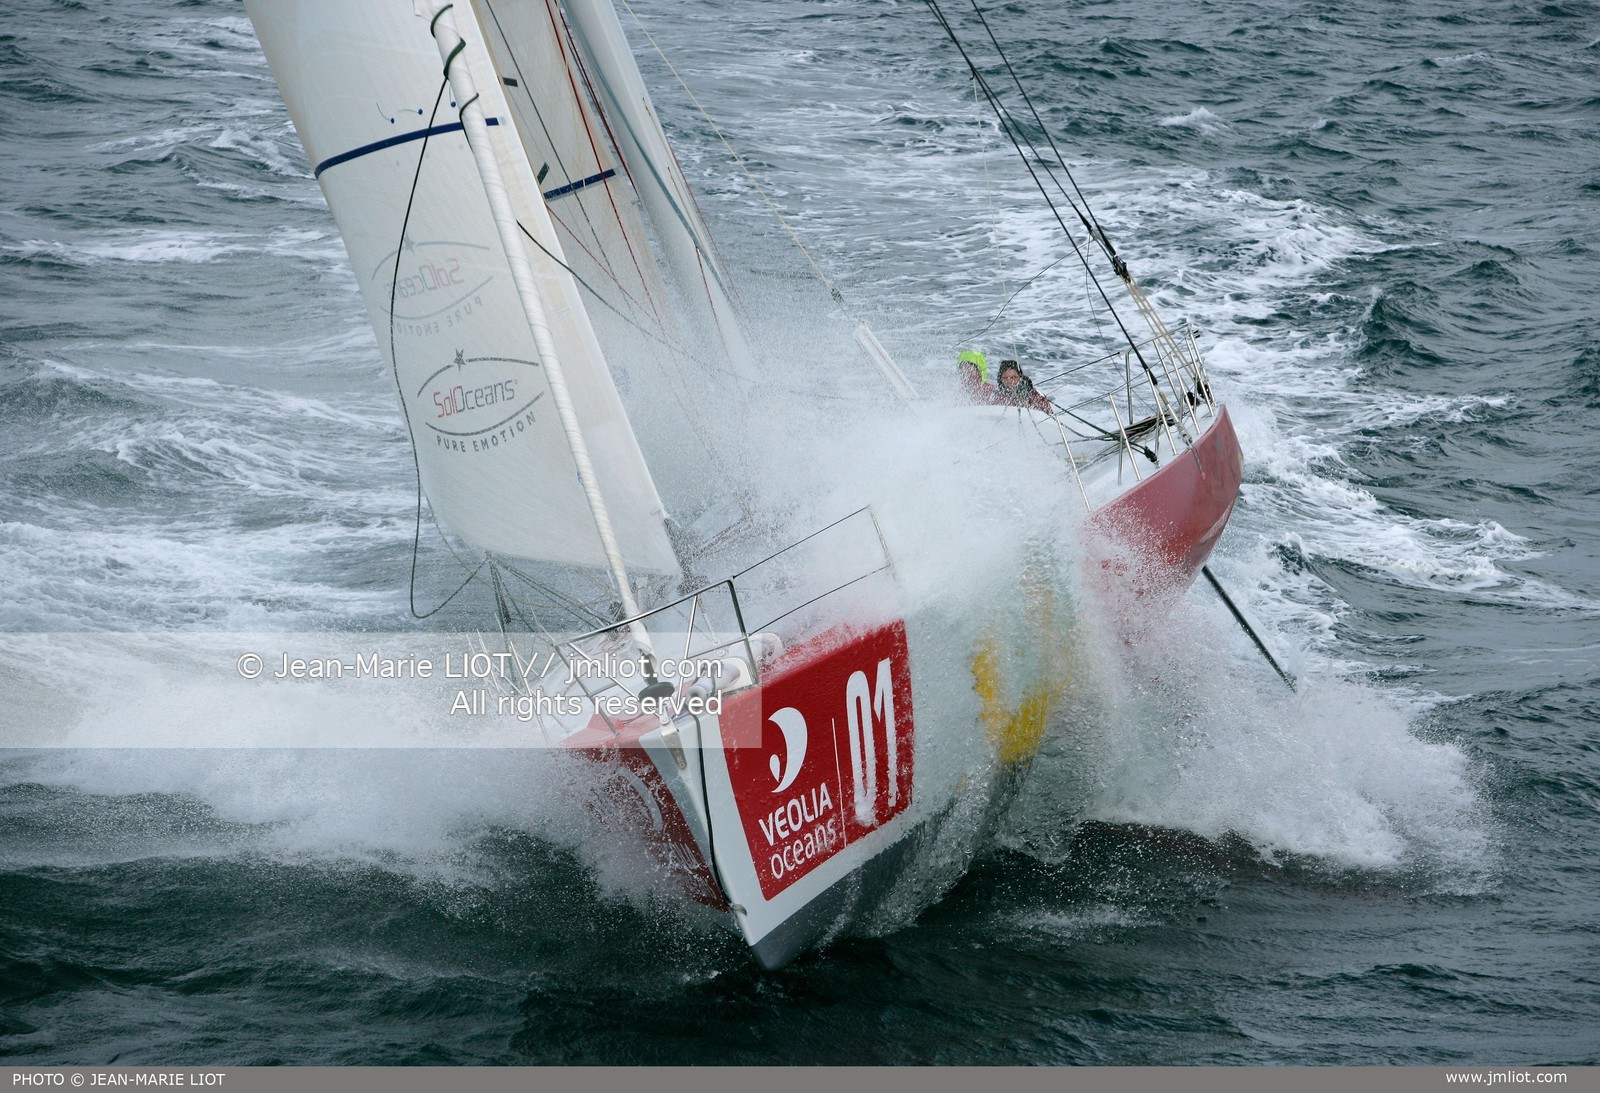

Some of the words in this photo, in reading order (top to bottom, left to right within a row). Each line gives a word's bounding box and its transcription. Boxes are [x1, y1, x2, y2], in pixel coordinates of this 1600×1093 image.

[433, 379, 515, 419] SolOceans
[436, 434, 466, 453] PURE
[472, 411, 537, 452] EMOTION
[846, 657, 898, 827] 01
[758, 782, 833, 847] VEOLIA
[770, 818, 837, 880] oceans
